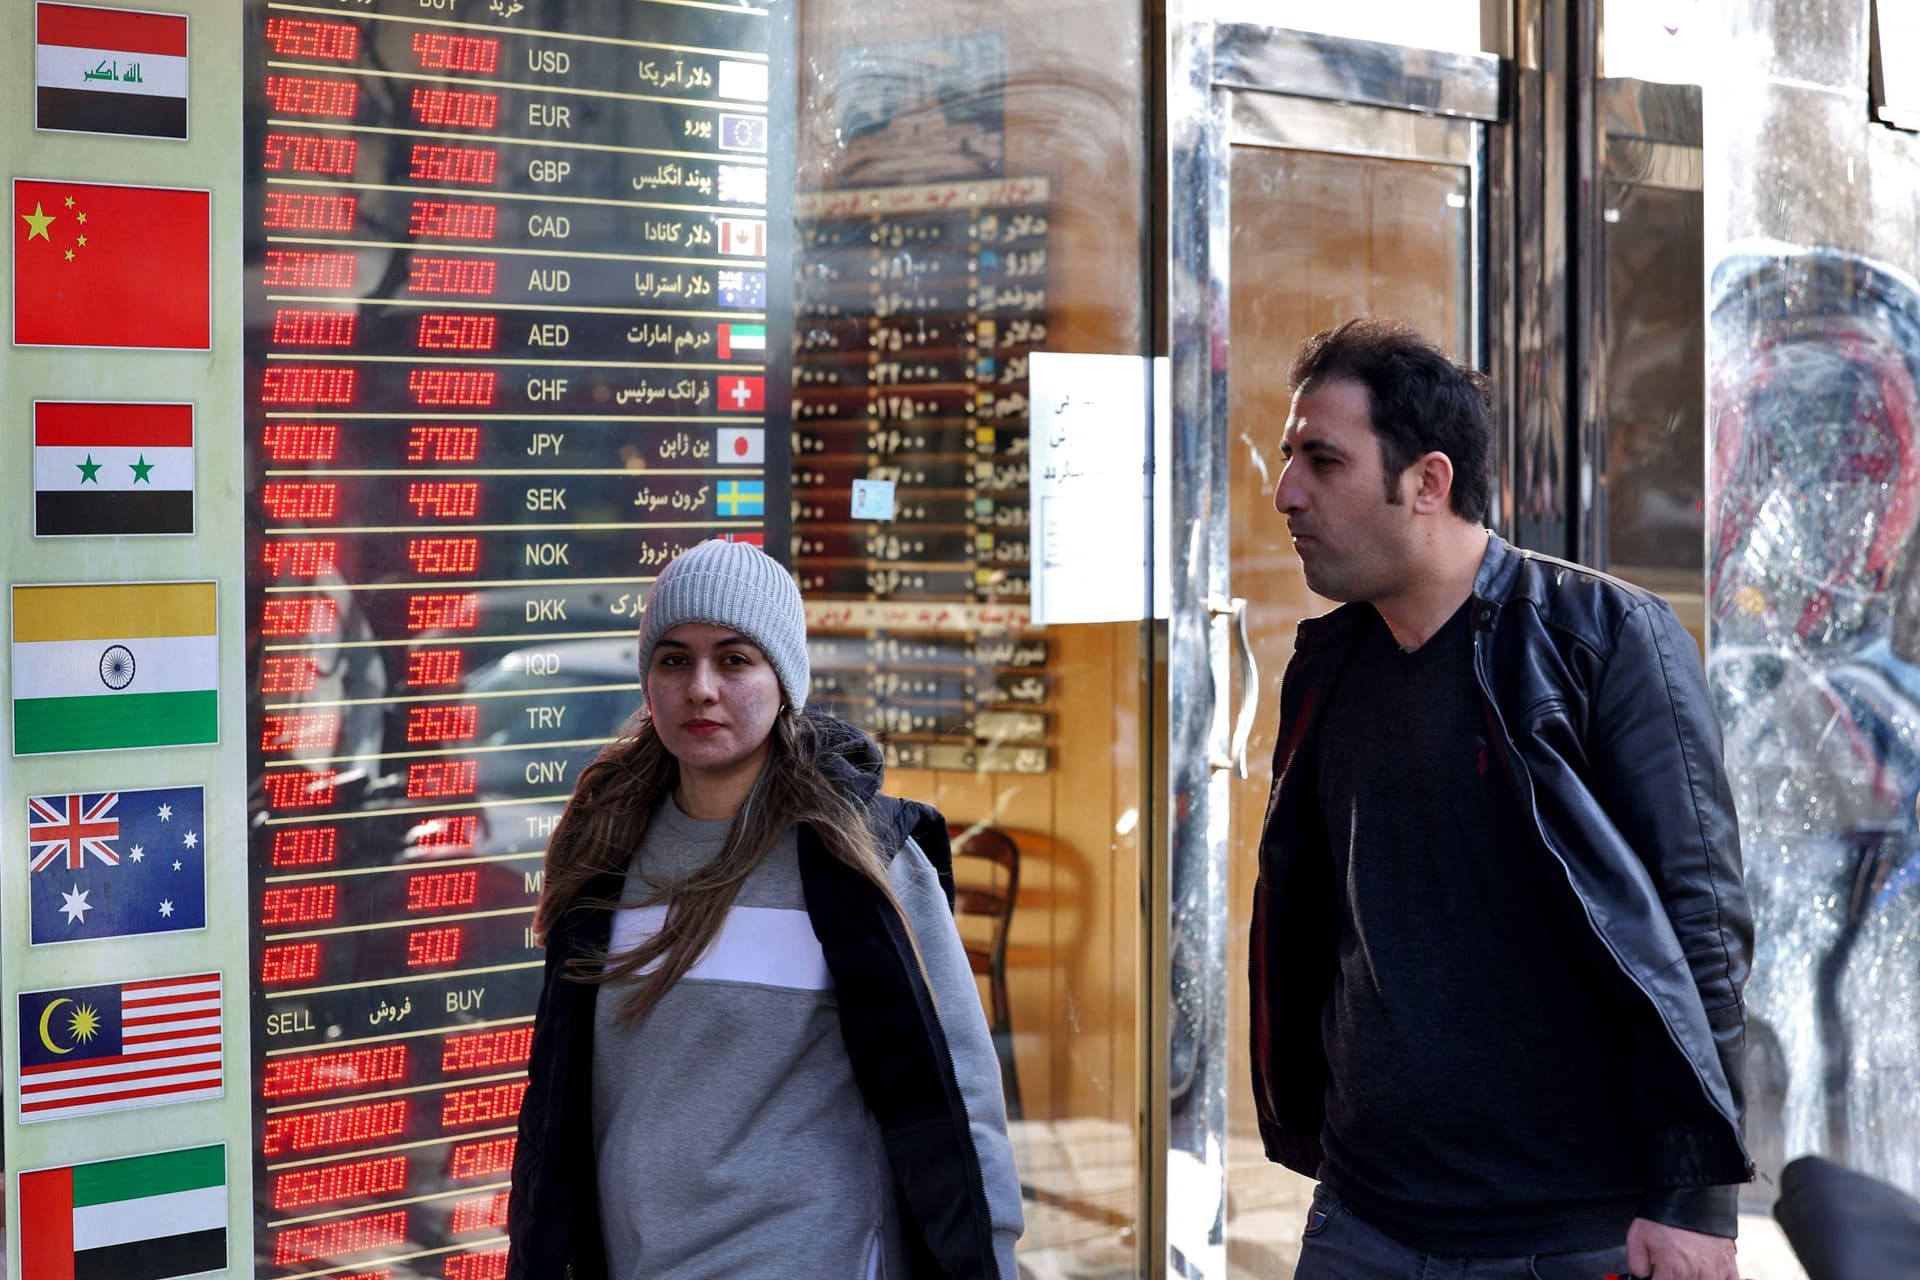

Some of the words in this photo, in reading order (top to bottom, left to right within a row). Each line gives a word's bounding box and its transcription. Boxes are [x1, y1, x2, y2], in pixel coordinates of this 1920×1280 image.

[267, 18, 357, 60] 45300
[413, 33, 498, 72] 45000
[528, 49, 570, 74] USD
[639, 61, 683, 87] آمریکا
[685, 67, 712, 88] دلار
[266, 76, 356, 116] 48300
[412, 88, 497, 127] 48000
[528, 104, 571, 128] EUR
[684, 118, 712, 138] یورو
[264, 135, 356, 174] 57000
[410, 145, 496, 183] 56000
[528, 160, 571, 183] GBP
[633, 163, 682, 190] انگلیس
[685, 170, 712, 194] پوند
[263, 193, 356, 230] 36000
[409, 201, 496, 239] 35000
[528, 215, 570, 239] CAD
[645, 222, 682, 242] کانادا
[685, 224, 711, 247] دلار
[263, 251, 355, 288] 33000
[408, 258, 496, 294] 32000
[528, 269, 571, 292] AUD
[634, 272, 681, 298] استرالیا
[685, 276, 711, 298] دلار
[273, 309, 354, 345] 13000
[418, 314, 495, 349] 12500
[528, 324, 570, 347] AED
[627, 324, 672, 347] امارات
[675, 332, 710, 354] درهم
[262, 368, 354, 403] 50000
[409, 370, 495, 405] 49000
[527, 378, 568, 402] CHF
[669, 379, 710, 405] فرانک
[264, 426, 336, 460] 4000
[408, 427, 478, 461] 3700
[527, 433, 564, 456] JPY
[659, 432, 689, 458] ژاپن
[692, 438, 710, 458] ین
[264, 484, 336, 518] 4600
[409, 483, 478, 517] 4400
[526, 488, 567, 511] SEK
[672, 486, 709, 511] کرون
[264, 542, 336, 577] 4700
[408, 539, 477, 573] 4500
[525, 543, 569, 566] NOK
[639, 541, 668, 565] نروژ
[262, 599, 336, 635] 5800
[407, 594, 477, 629] 5600
[525, 599, 567, 622] DKK
[262, 657, 318, 692] 330
[407, 650, 461, 685] 300
[526, 653, 560, 676] IQD
[407, 705, 477, 742] 2600
[526, 706, 566, 729] TRY
[264, 770, 336, 808] 7000
[407, 760, 477, 798] 6500
[525, 760, 568, 784] CNY
[273, 828, 337, 866] 1300
[262, 885, 337, 924] 9500
[407, 871, 477, 910] 9000
[262, 944, 318, 982] 600
[407, 928, 461, 966] 500
[369, 996, 412, 1024] فروش
[446, 988, 485, 1013] BUY
[266, 1009, 316, 1036] SELL
[263, 1045, 406, 1097] 29000000
[442, 1081, 531, 1126] 26500
[264, 1101, 406, 1154] 27000000
[275, 1156, 406, 1209] 15500000
[275, 1211, 406, 1265] 10500000
